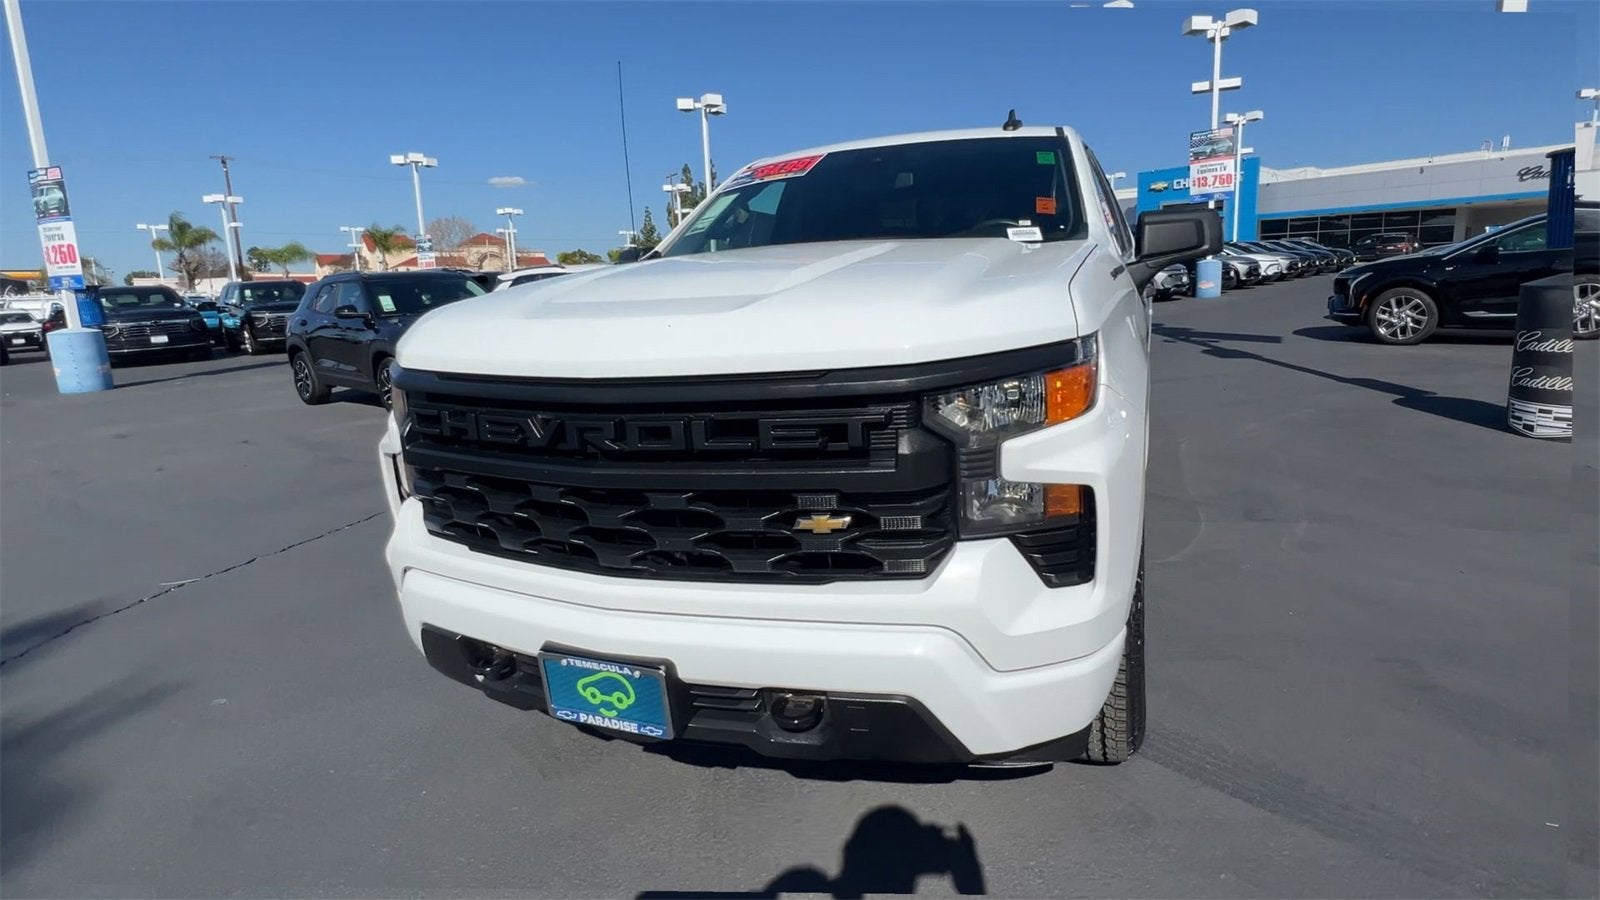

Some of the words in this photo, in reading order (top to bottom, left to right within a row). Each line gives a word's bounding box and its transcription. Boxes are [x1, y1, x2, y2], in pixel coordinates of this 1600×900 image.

[409, 407, 890, 454] CHEVROLET
[567, 658, 632, 675] TEMECULA
[579, 712, 639, 733] PARADISE
